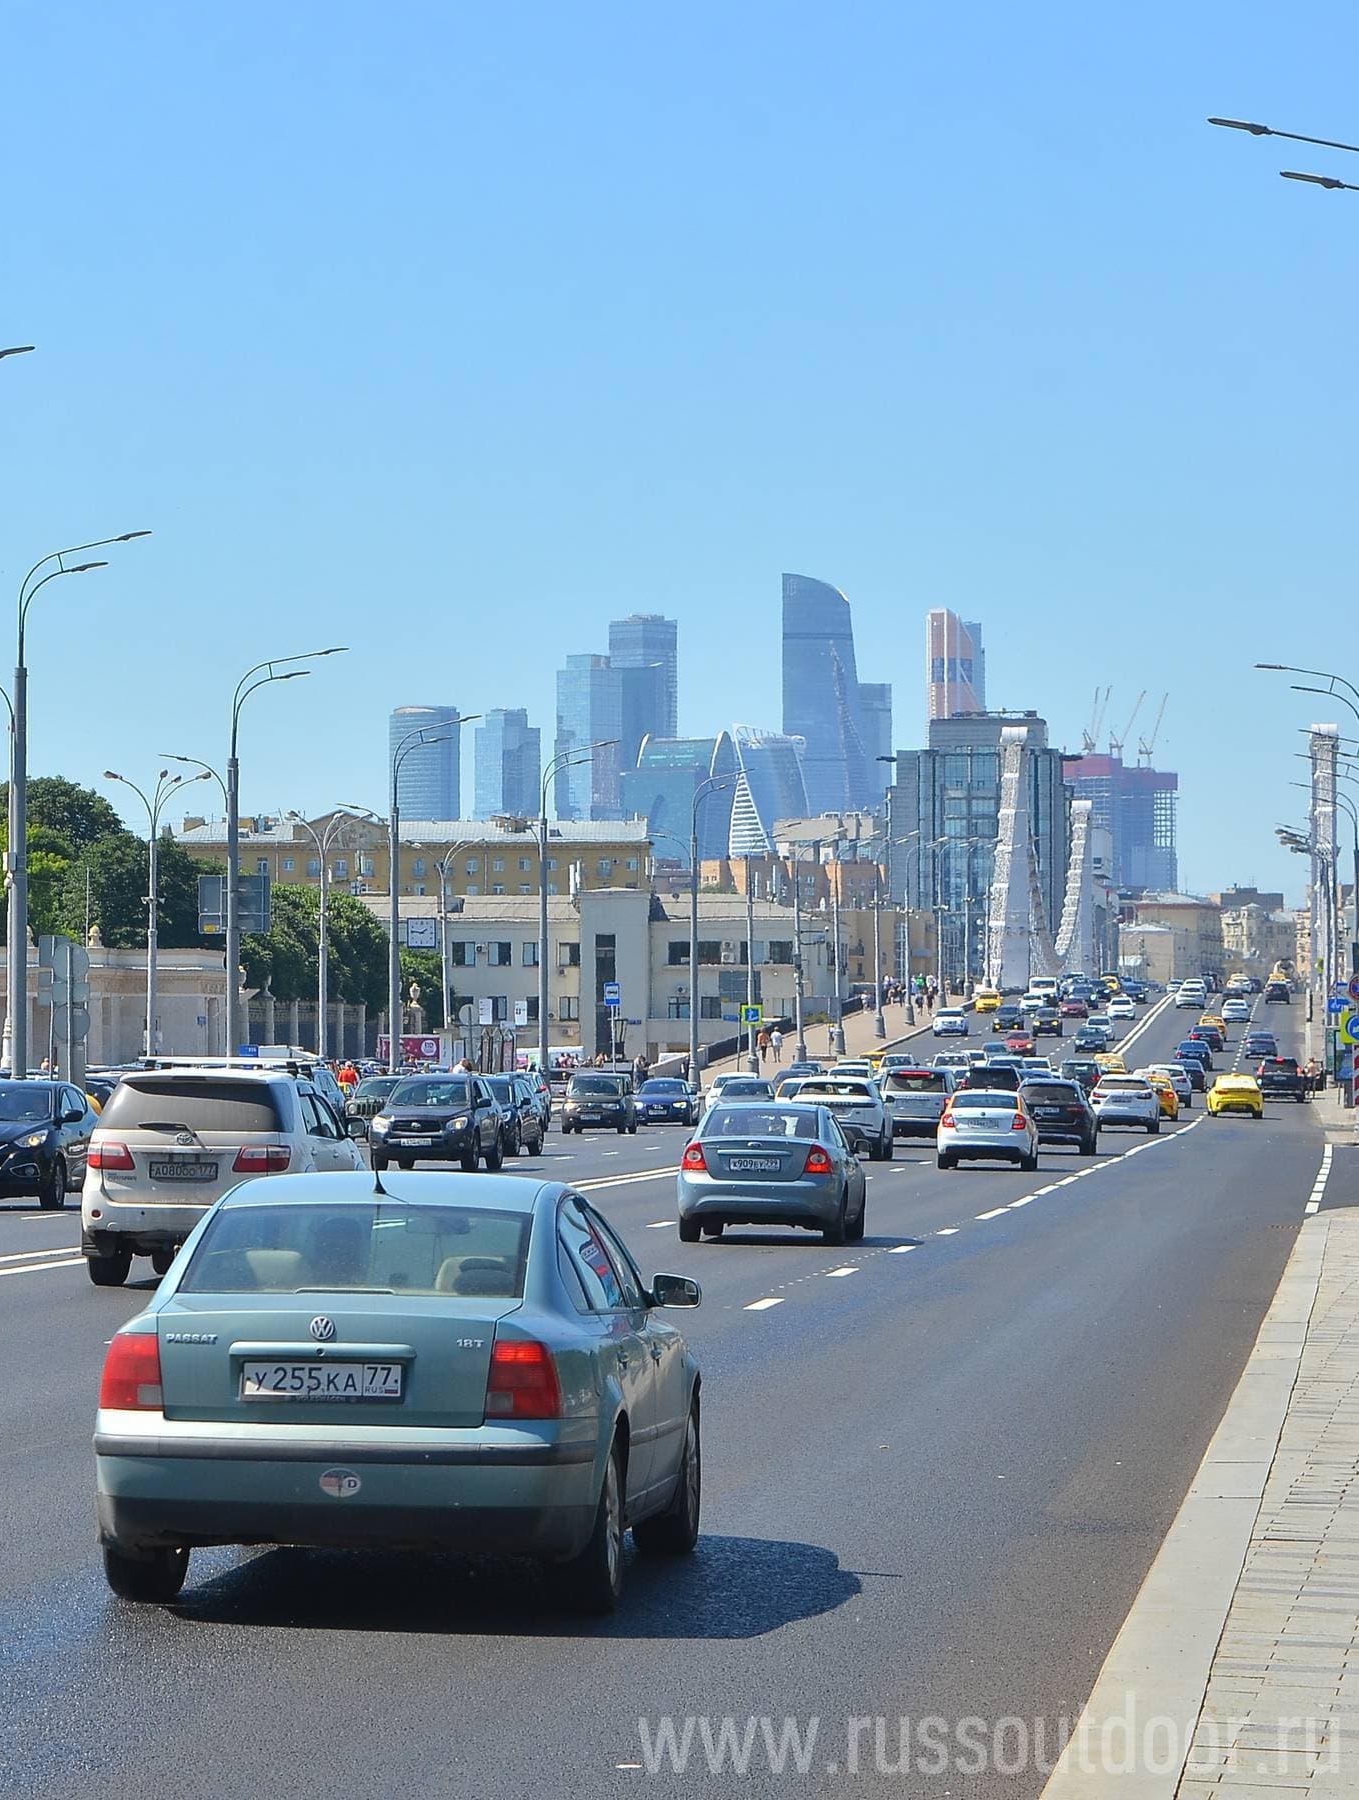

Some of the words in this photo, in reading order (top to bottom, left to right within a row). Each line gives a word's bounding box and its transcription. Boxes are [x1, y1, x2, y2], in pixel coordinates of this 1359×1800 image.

[165, 1333, 218, 1344] PASSAT
[364, 1386, 384, 1394] RUS
[348, 1479, 358, 1488] D
